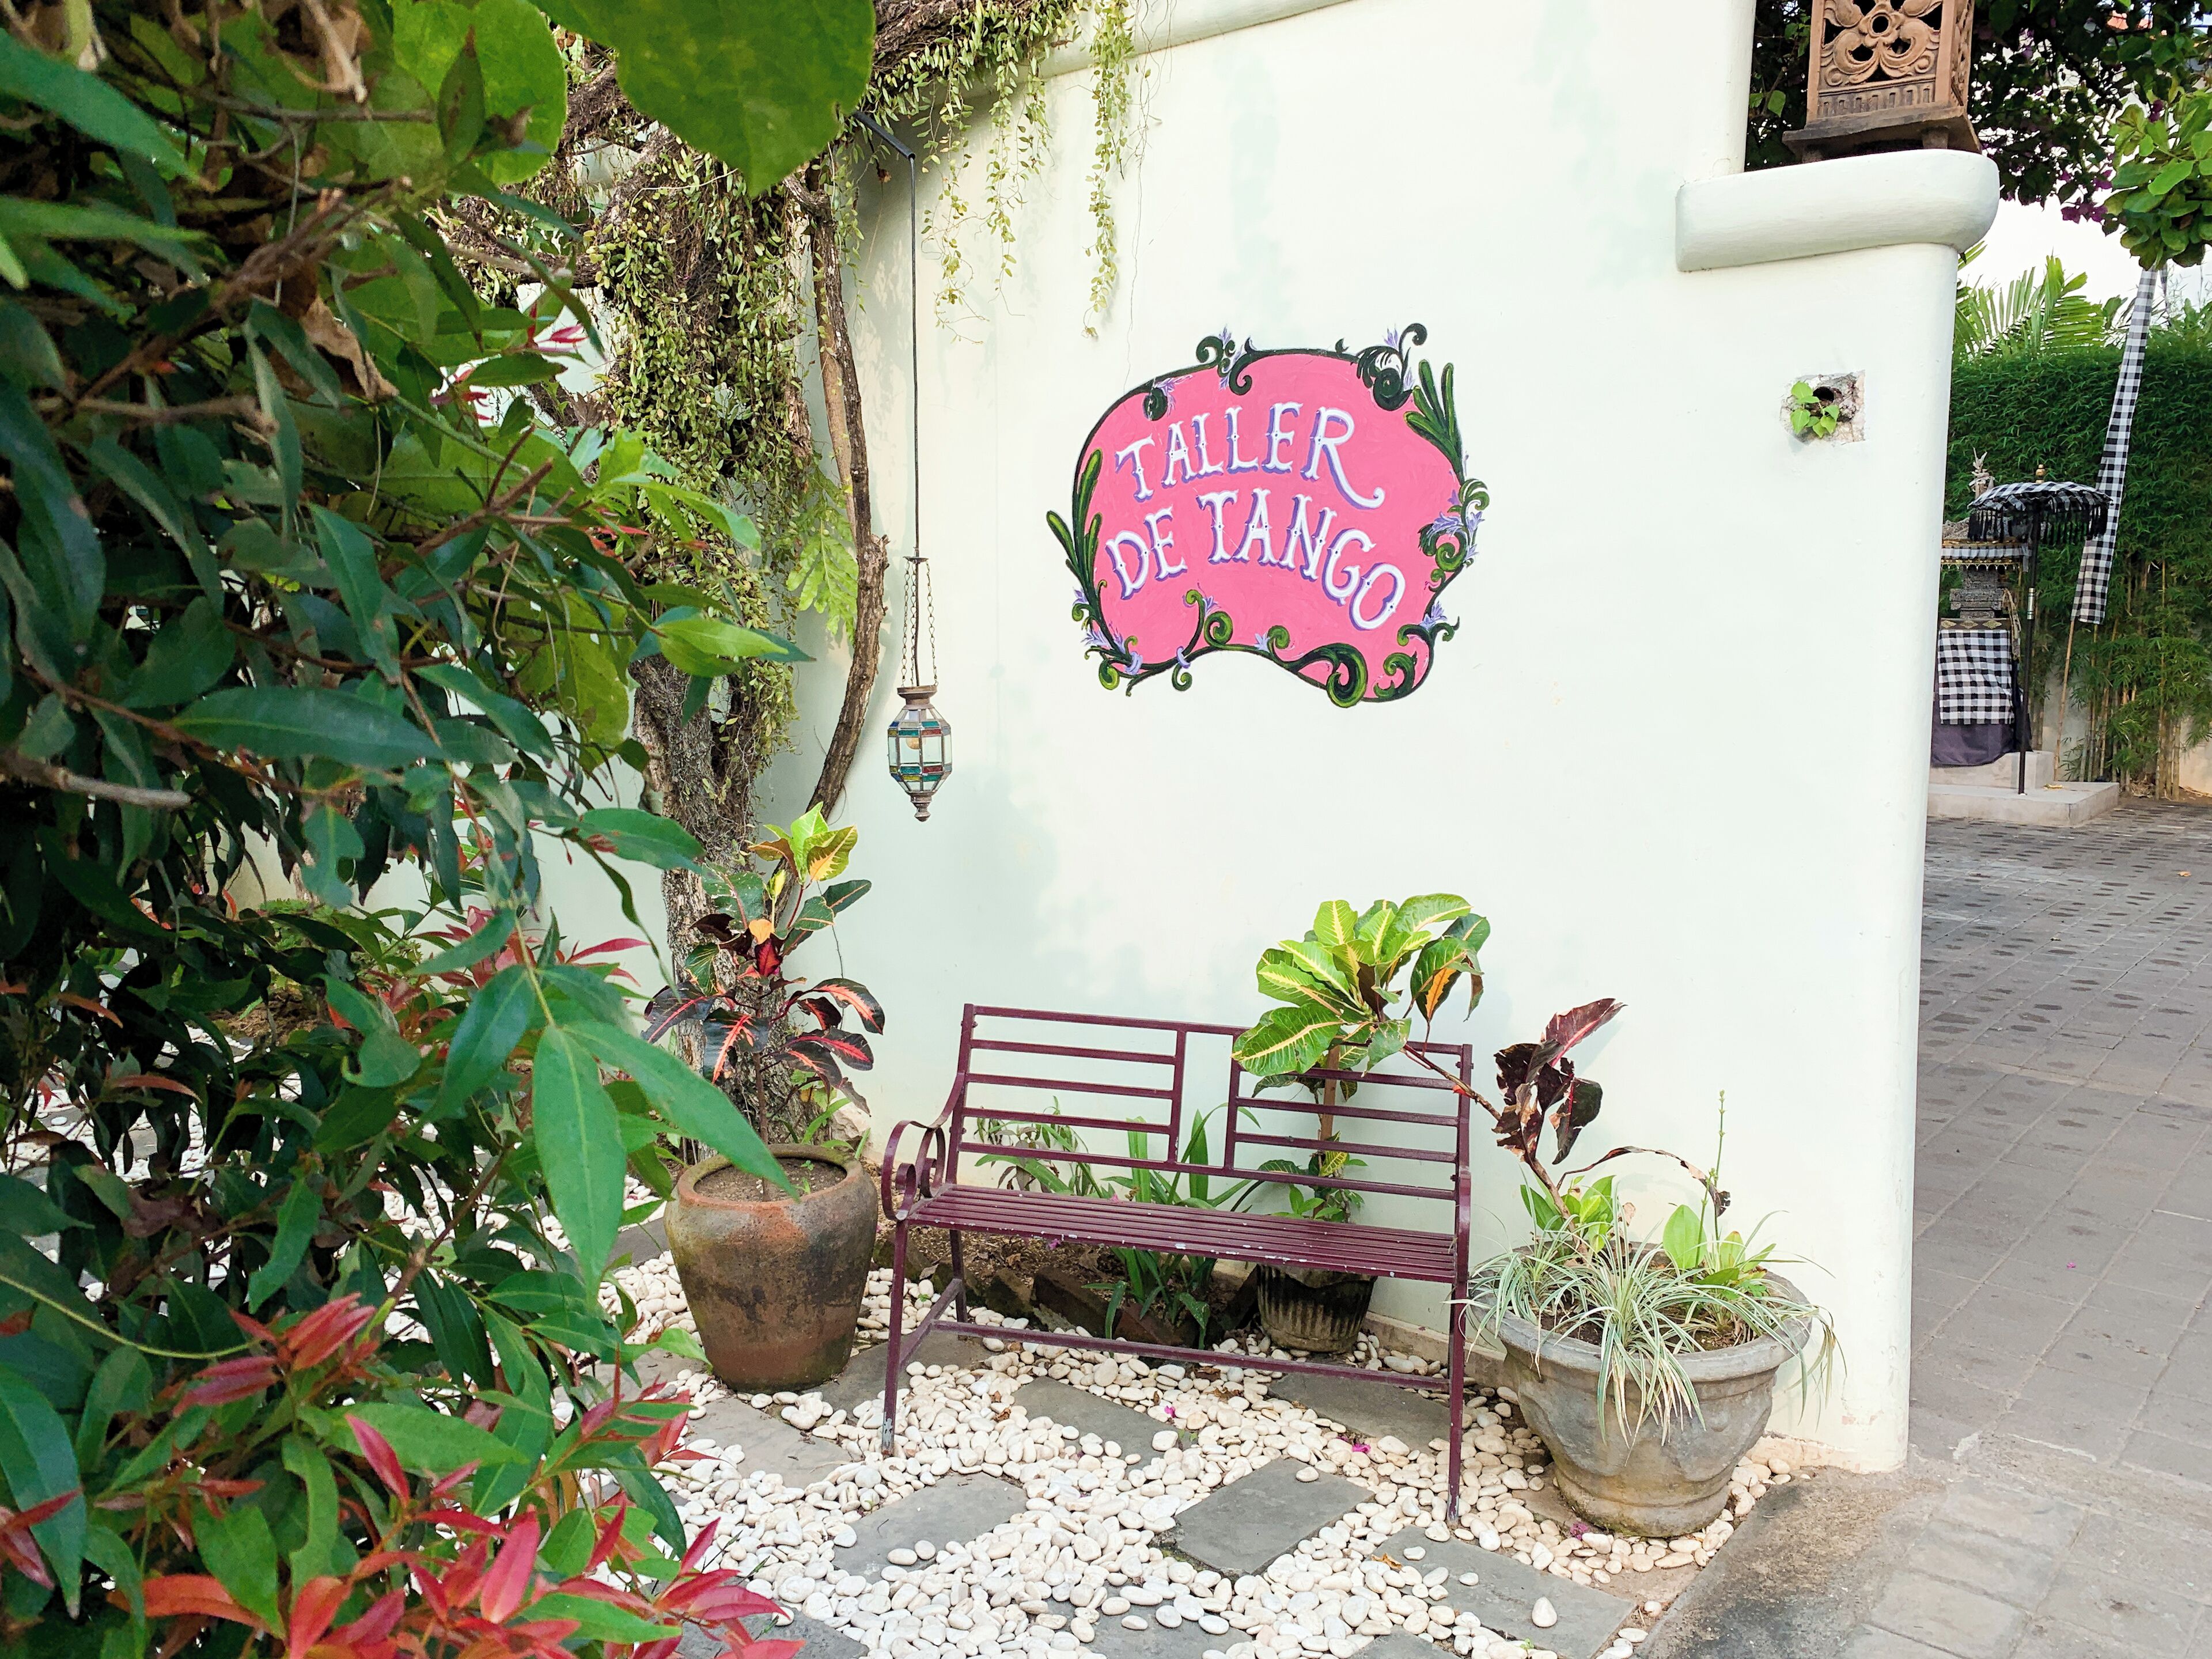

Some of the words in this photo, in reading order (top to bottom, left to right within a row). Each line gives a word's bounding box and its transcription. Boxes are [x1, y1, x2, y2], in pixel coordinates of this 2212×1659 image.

[1115, 402, 1384, 509] TALLER
[1105, 506, 1187, 600] DE
[1197, 488, 1405, 631] TANGO
